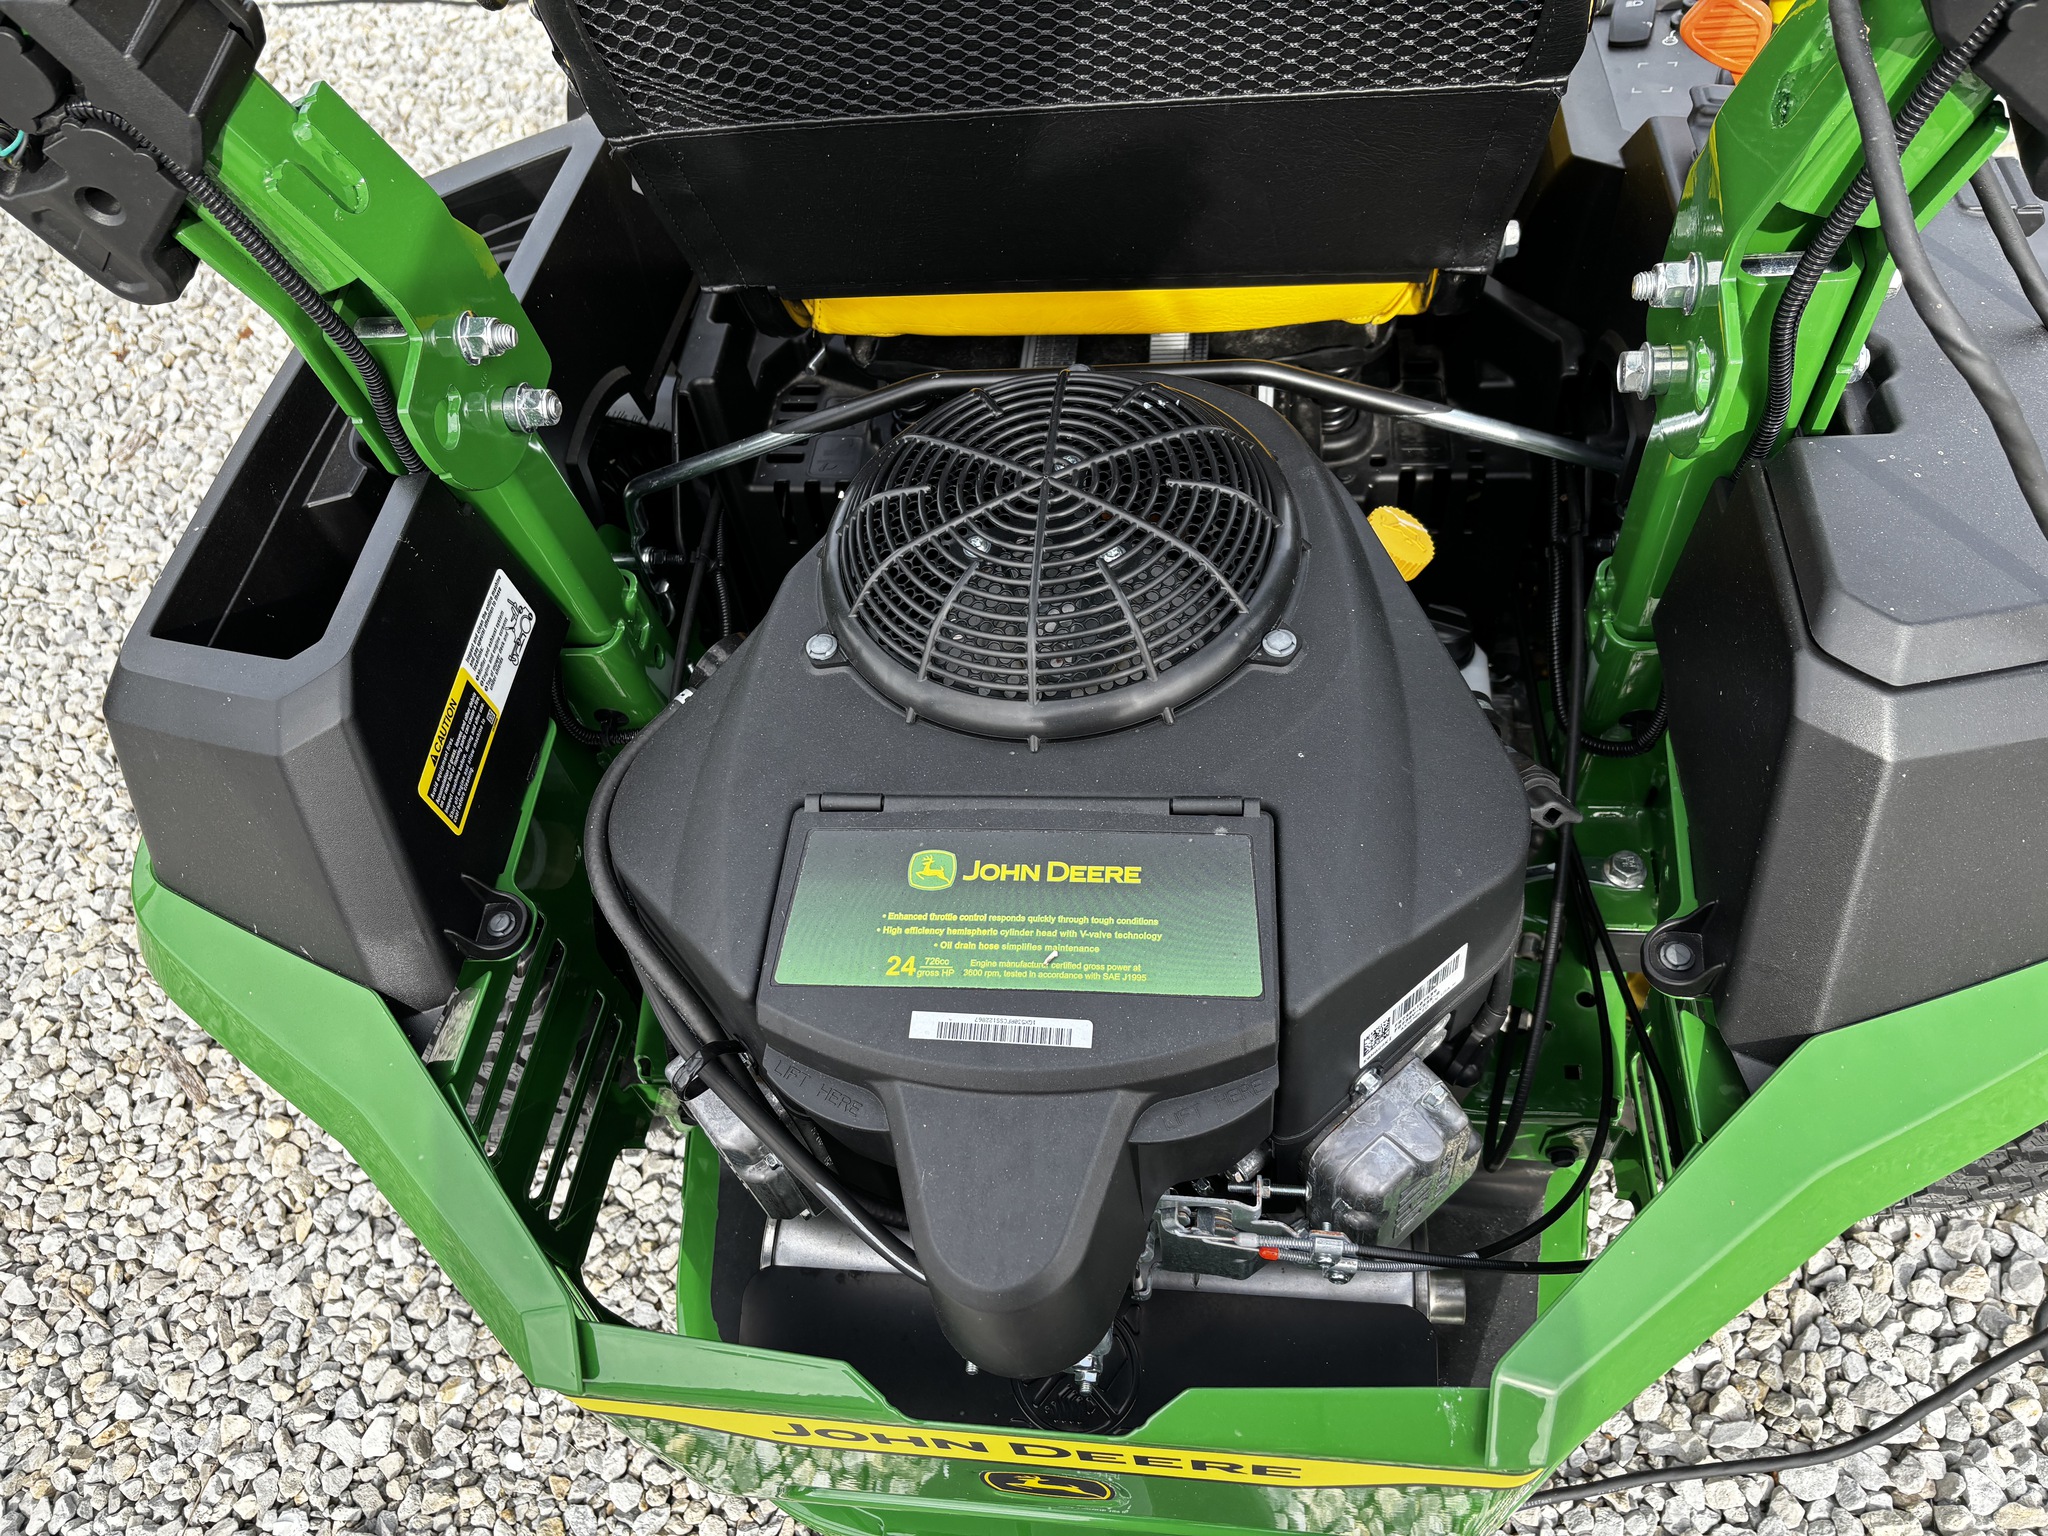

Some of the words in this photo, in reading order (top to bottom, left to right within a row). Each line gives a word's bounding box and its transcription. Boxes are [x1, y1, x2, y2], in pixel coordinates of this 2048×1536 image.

[434, 698, 457, 753] CAUTION
[962, 860, 1041, 882] JOHN
[1046, 861, 1142, 884] DEERE
[888, 912, 928, 921] Enhanced
[930, 912, 957, 921] throttle
[959, 913, 987, 922] control
[988, 914, 1026, 923] responds
[1028, 915, 1056, 924] quickly
[1058, 915, 1089, 925] through
[1091, 916, 1114, 925] tough
[1116, 916, 1159, 926] conditions
[882, 926, 902, 936] High
[904, 926, 945, 936] efficiency
[946, 927, 998, 937] hemispheric
[1000, 928, 1034, 938] cylinder
[1036, 929, 1058, 938] head
[1060, 930, 1078, 938] with
[1080, 930, 1113, 939] V-valve
[1114, 931, 1162, 941] technology
[940, 941, 952, 950] Oil
[954, 941, 976, 950] drain
[978, 941, 999, 950] hose
[1001, 942, 1043, 952] simplifies
[1044, 944, 1100, 953] maintenance
[885, 955, 916, 977] 24
[925, 957, 950, 966] 726cc
[970, 959, 997, 969] Engine
[1051, 962, 1082, 970] certified
[1083, 963, 1106, 972] gross
[1107, 963, 1131, 972] power
[1132, 963, 1142, 972] at
[916, 968, 940, 978] gross
[941, 968, 955, 977] HP
[963, 969, 982, 977] 3600
[984, 970, 1001, 978] rpm,
[1004, 970, 1027, 978] tested
[1029, 970, 1036, 979] in
[1038, 971, 1083, 980] accordance
[1085, 972, 1101, 980] with
[1103, 973, 1120, 981] SAE
[1122, 973, 1147, 981] J1995
[774, 1060, 811, 1087] LIFT
[816, 1083, 863, 1117] HERE
[1163, 1102, 1201, 1131] LIFT
[1213, 1080, 1268, 1110] HERE
[772, 1423, 990, 1453] JOHN
[1006, 1442, 1302, 1478] DEERE
